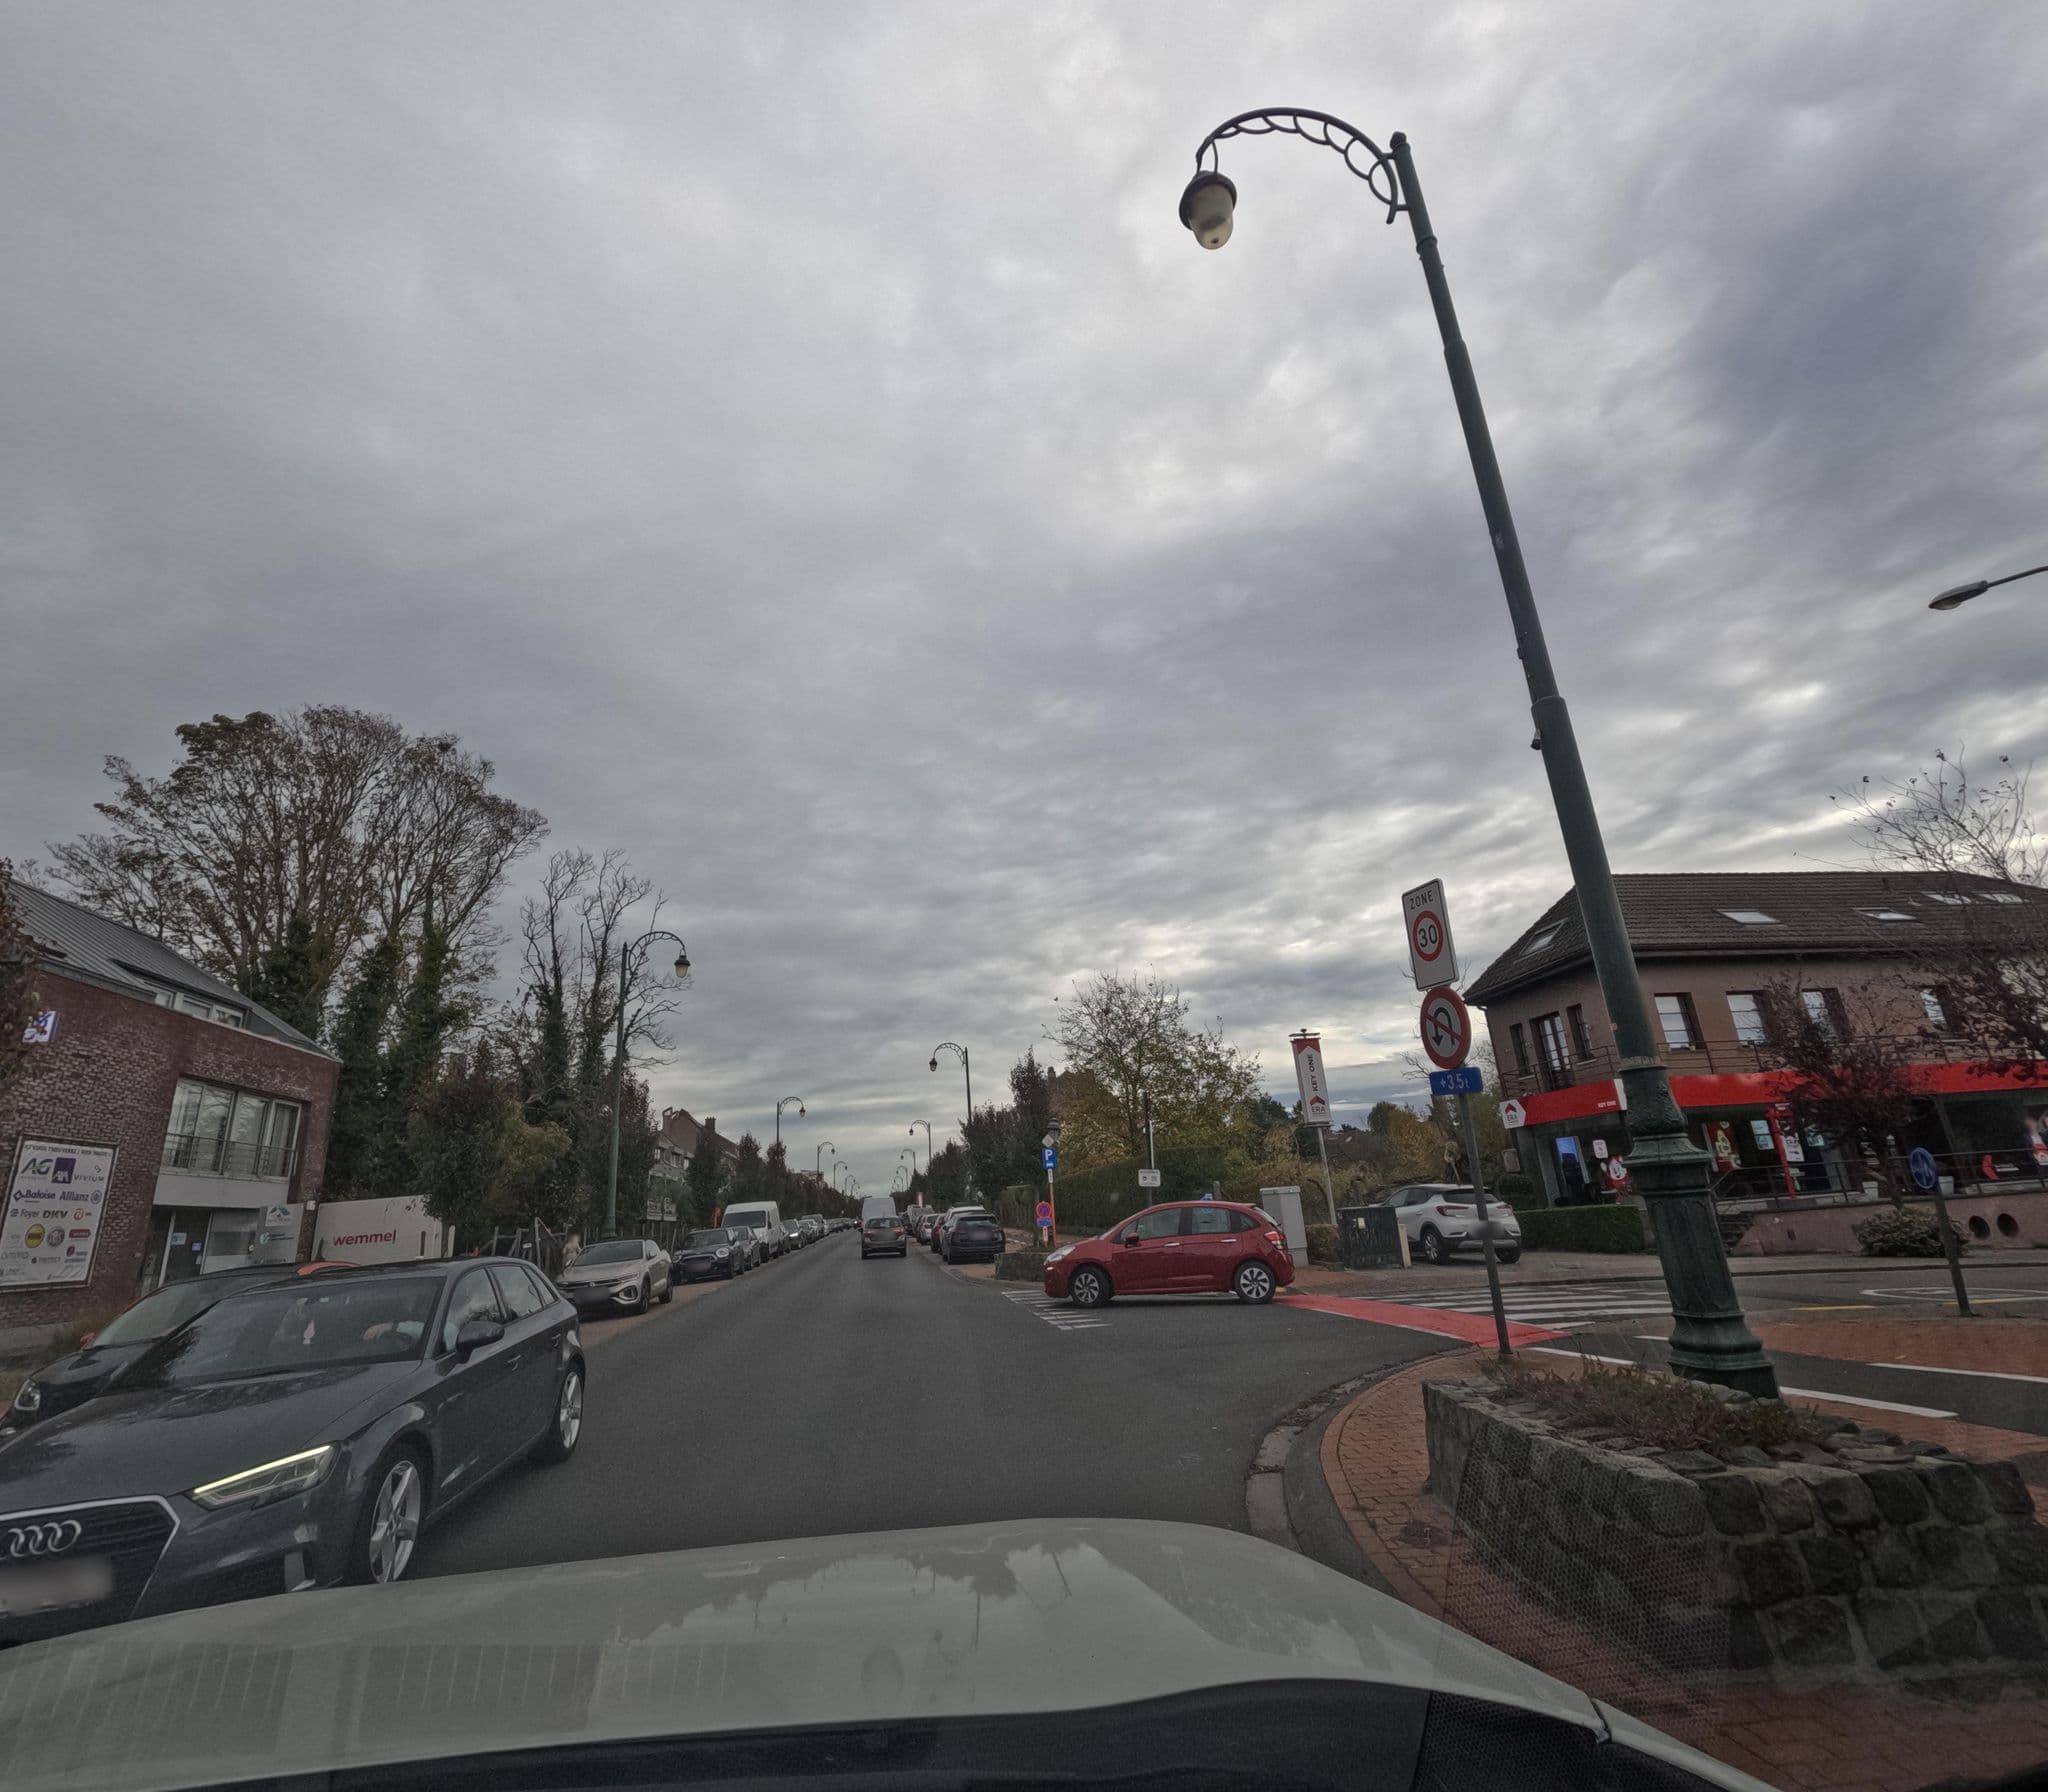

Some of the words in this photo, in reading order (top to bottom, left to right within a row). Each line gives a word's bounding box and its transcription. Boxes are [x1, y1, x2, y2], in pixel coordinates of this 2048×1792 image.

[1409, 890, 1434, 910] ZONE
[1418, 924, 1438, 948] 30
[1307, 1054, 1315, 1072] ONE
[1311, 1075, 1319, 1092] KEY
[1045, 1149, 1053, 1160] P
[21, 1157, 54, 1175] AG
[26, 1189, 56, 1200] Baloise
[60, 1190, 90, 1201] Allianz
[42, 1210, 69, 1219] DKV
[333, 1229, 397, 1246] wemmel
